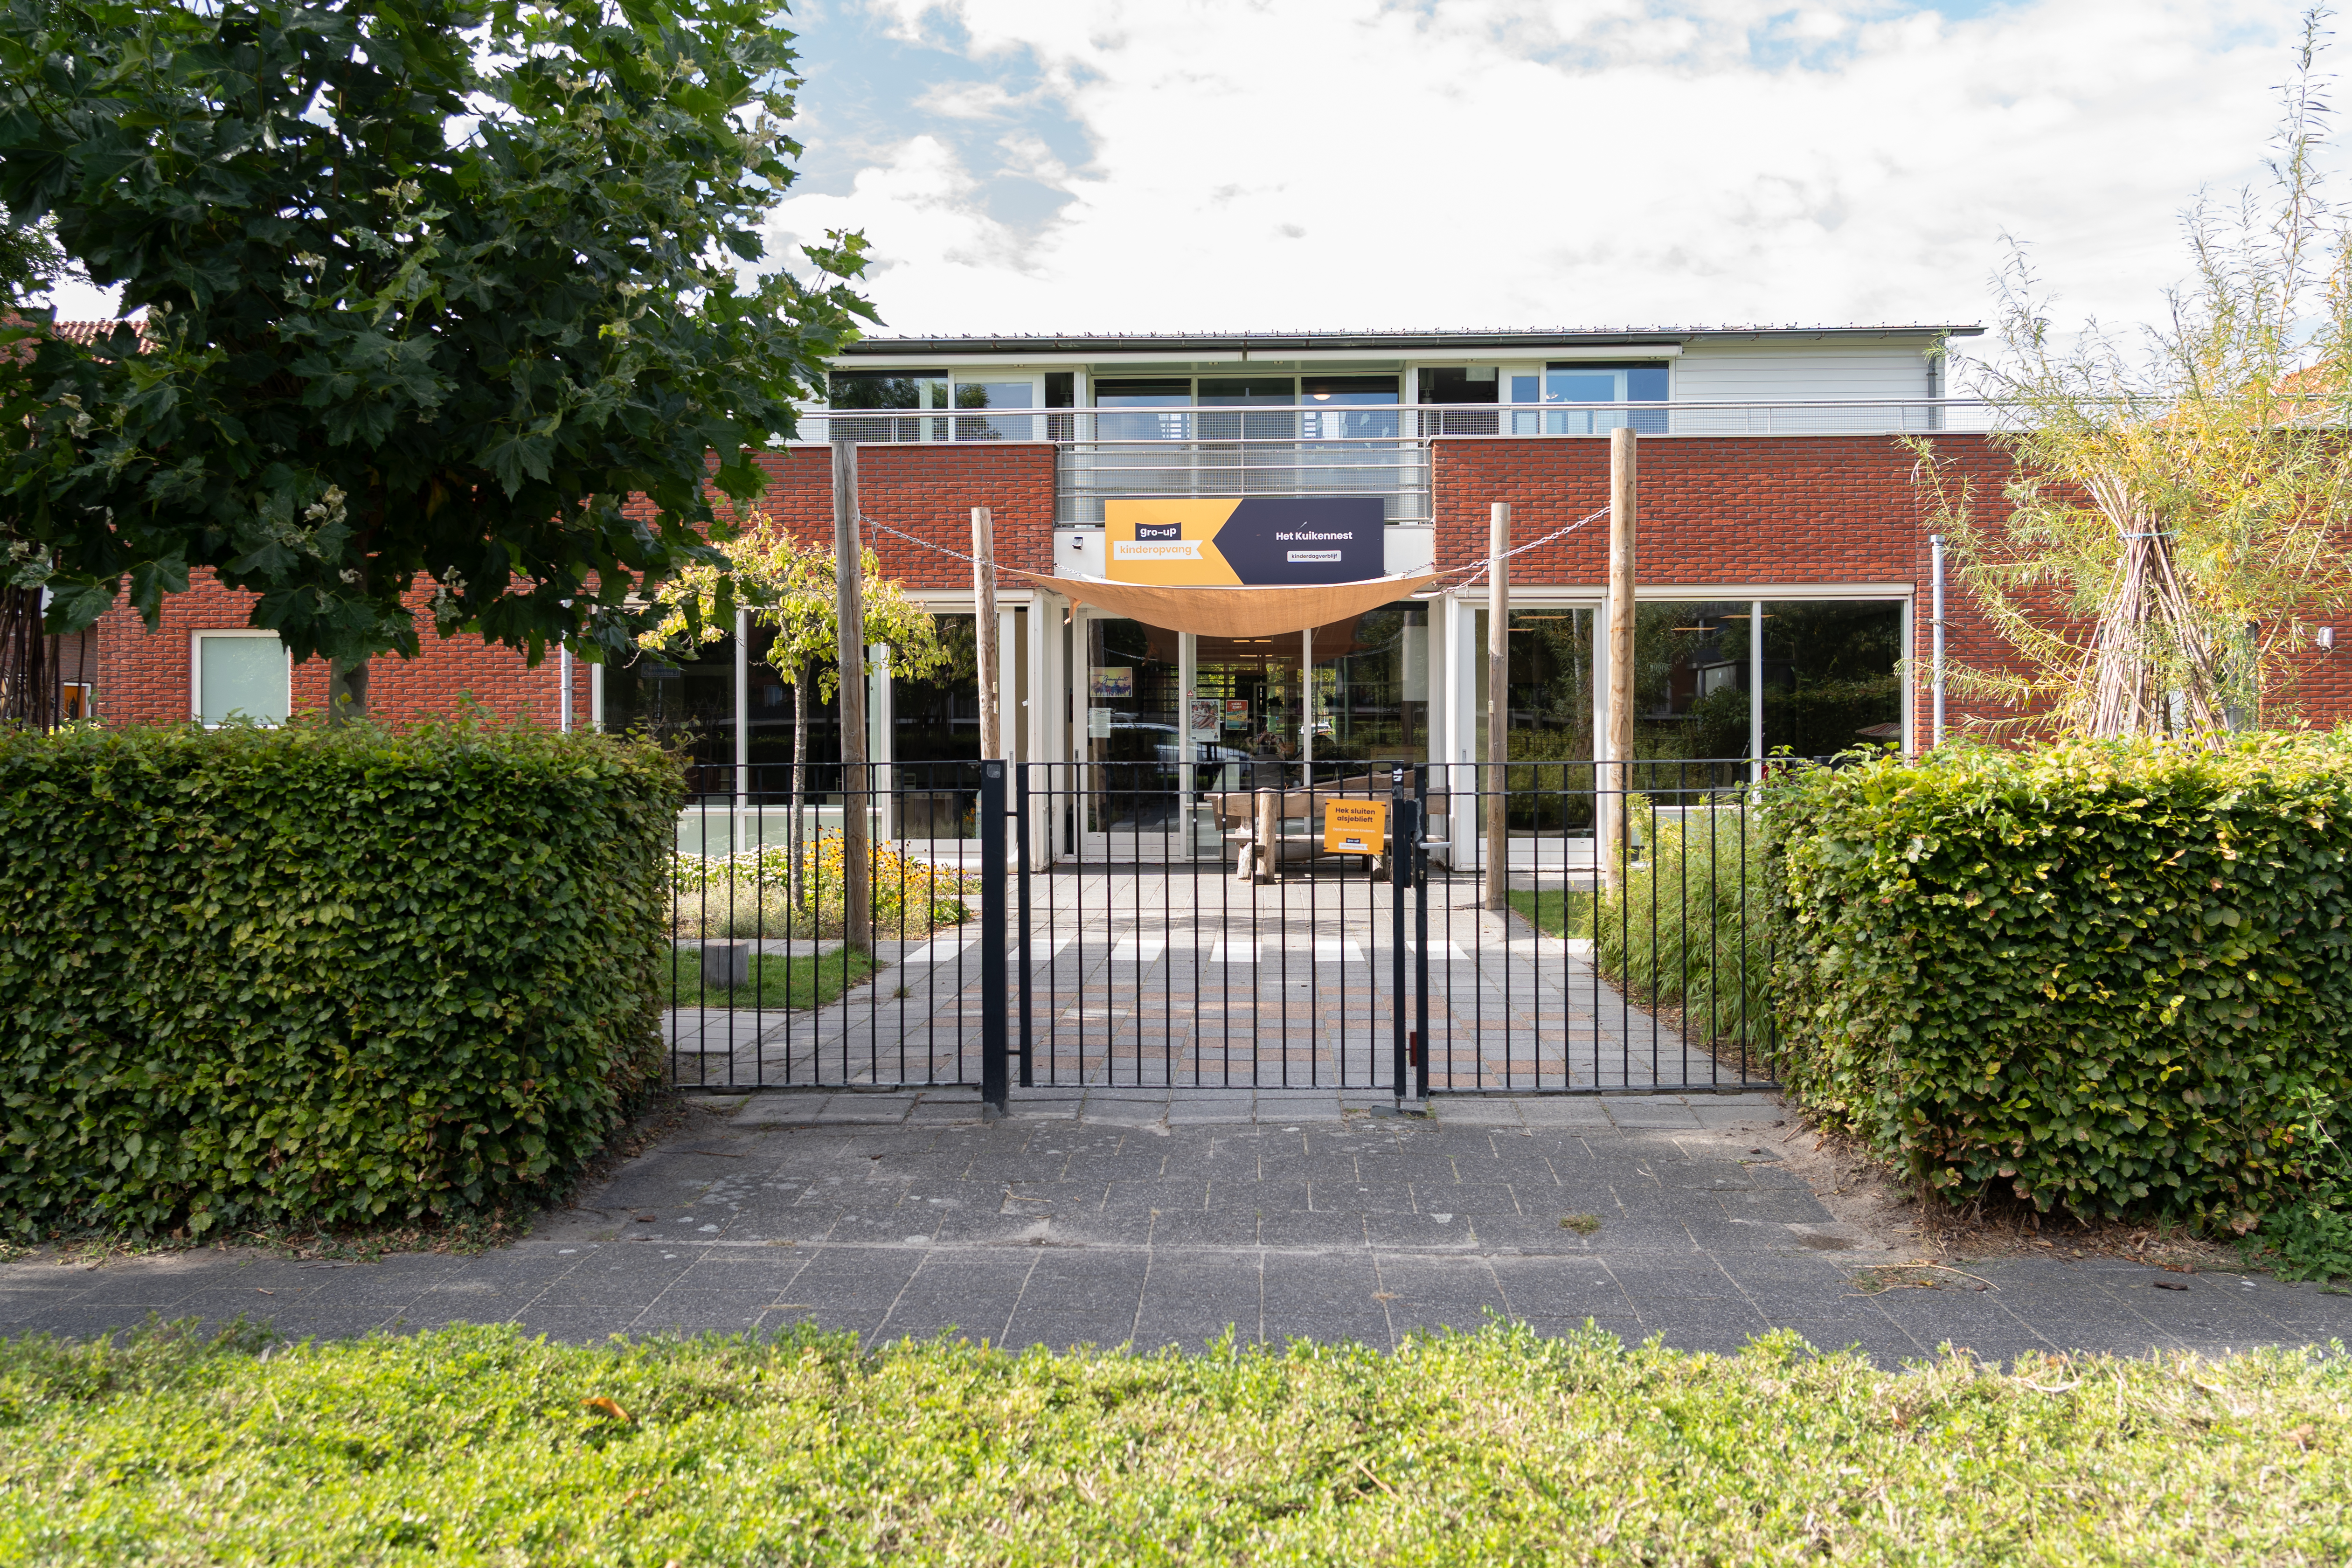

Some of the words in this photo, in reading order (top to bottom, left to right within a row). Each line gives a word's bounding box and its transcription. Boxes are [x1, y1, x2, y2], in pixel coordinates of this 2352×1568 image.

[1140, 527, 1177, 538] gro-up
[1276, 532, 1294, 541] Het
[1295, 531, 1353, 540] Kuikennest
[1120, 545, 1192, 555] kinderopvang
